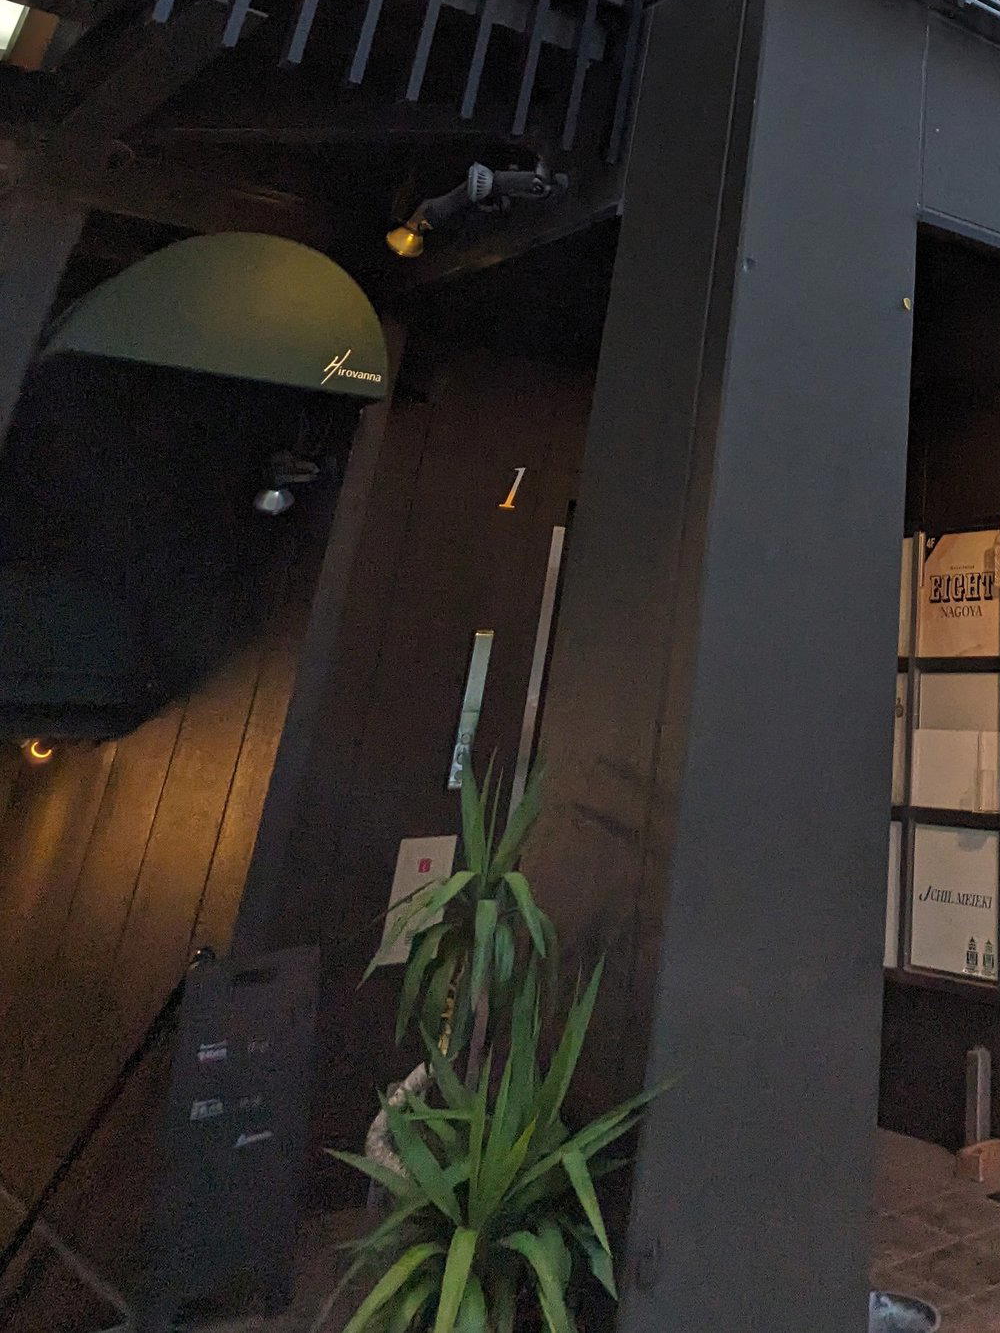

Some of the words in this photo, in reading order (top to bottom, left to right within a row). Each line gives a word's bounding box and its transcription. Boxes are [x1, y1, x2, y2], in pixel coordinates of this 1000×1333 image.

[321, 349, 382, 385] Hirovanna
[929, 571, 995, 603] EIGHT
[941, 605, 983, 618] NAGOYA
